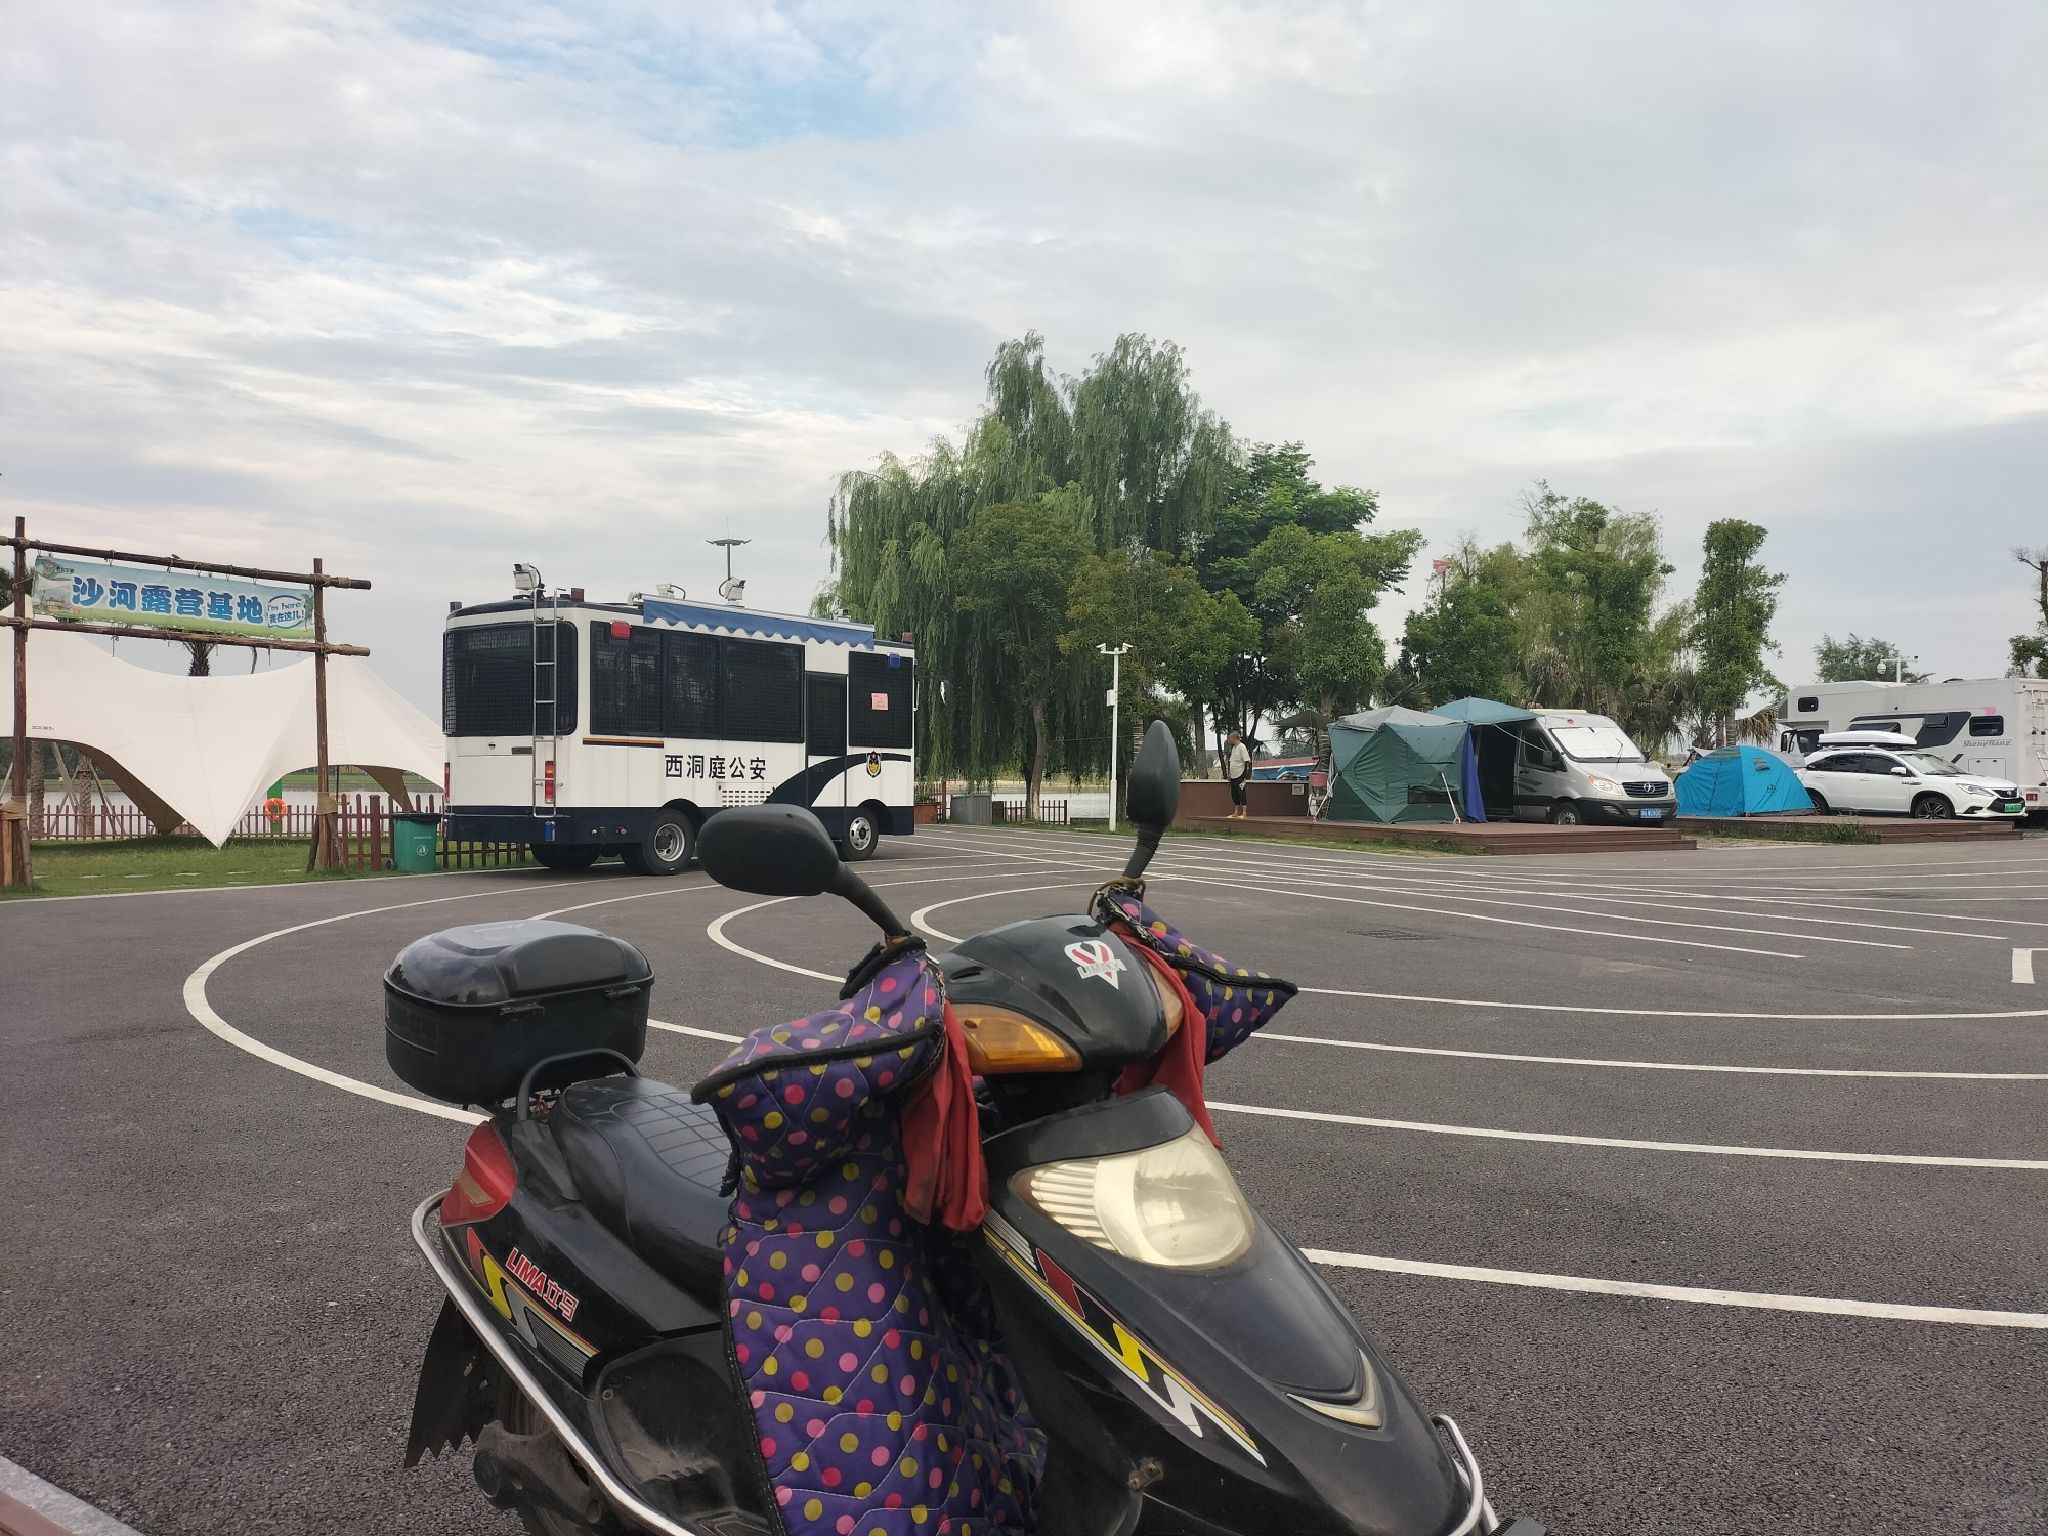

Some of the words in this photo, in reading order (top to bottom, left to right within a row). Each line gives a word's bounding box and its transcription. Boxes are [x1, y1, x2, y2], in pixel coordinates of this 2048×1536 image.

[73, 577, 263, 624] 沙河露营基地
[665, 755, 766, 780] 西洞庭公安
